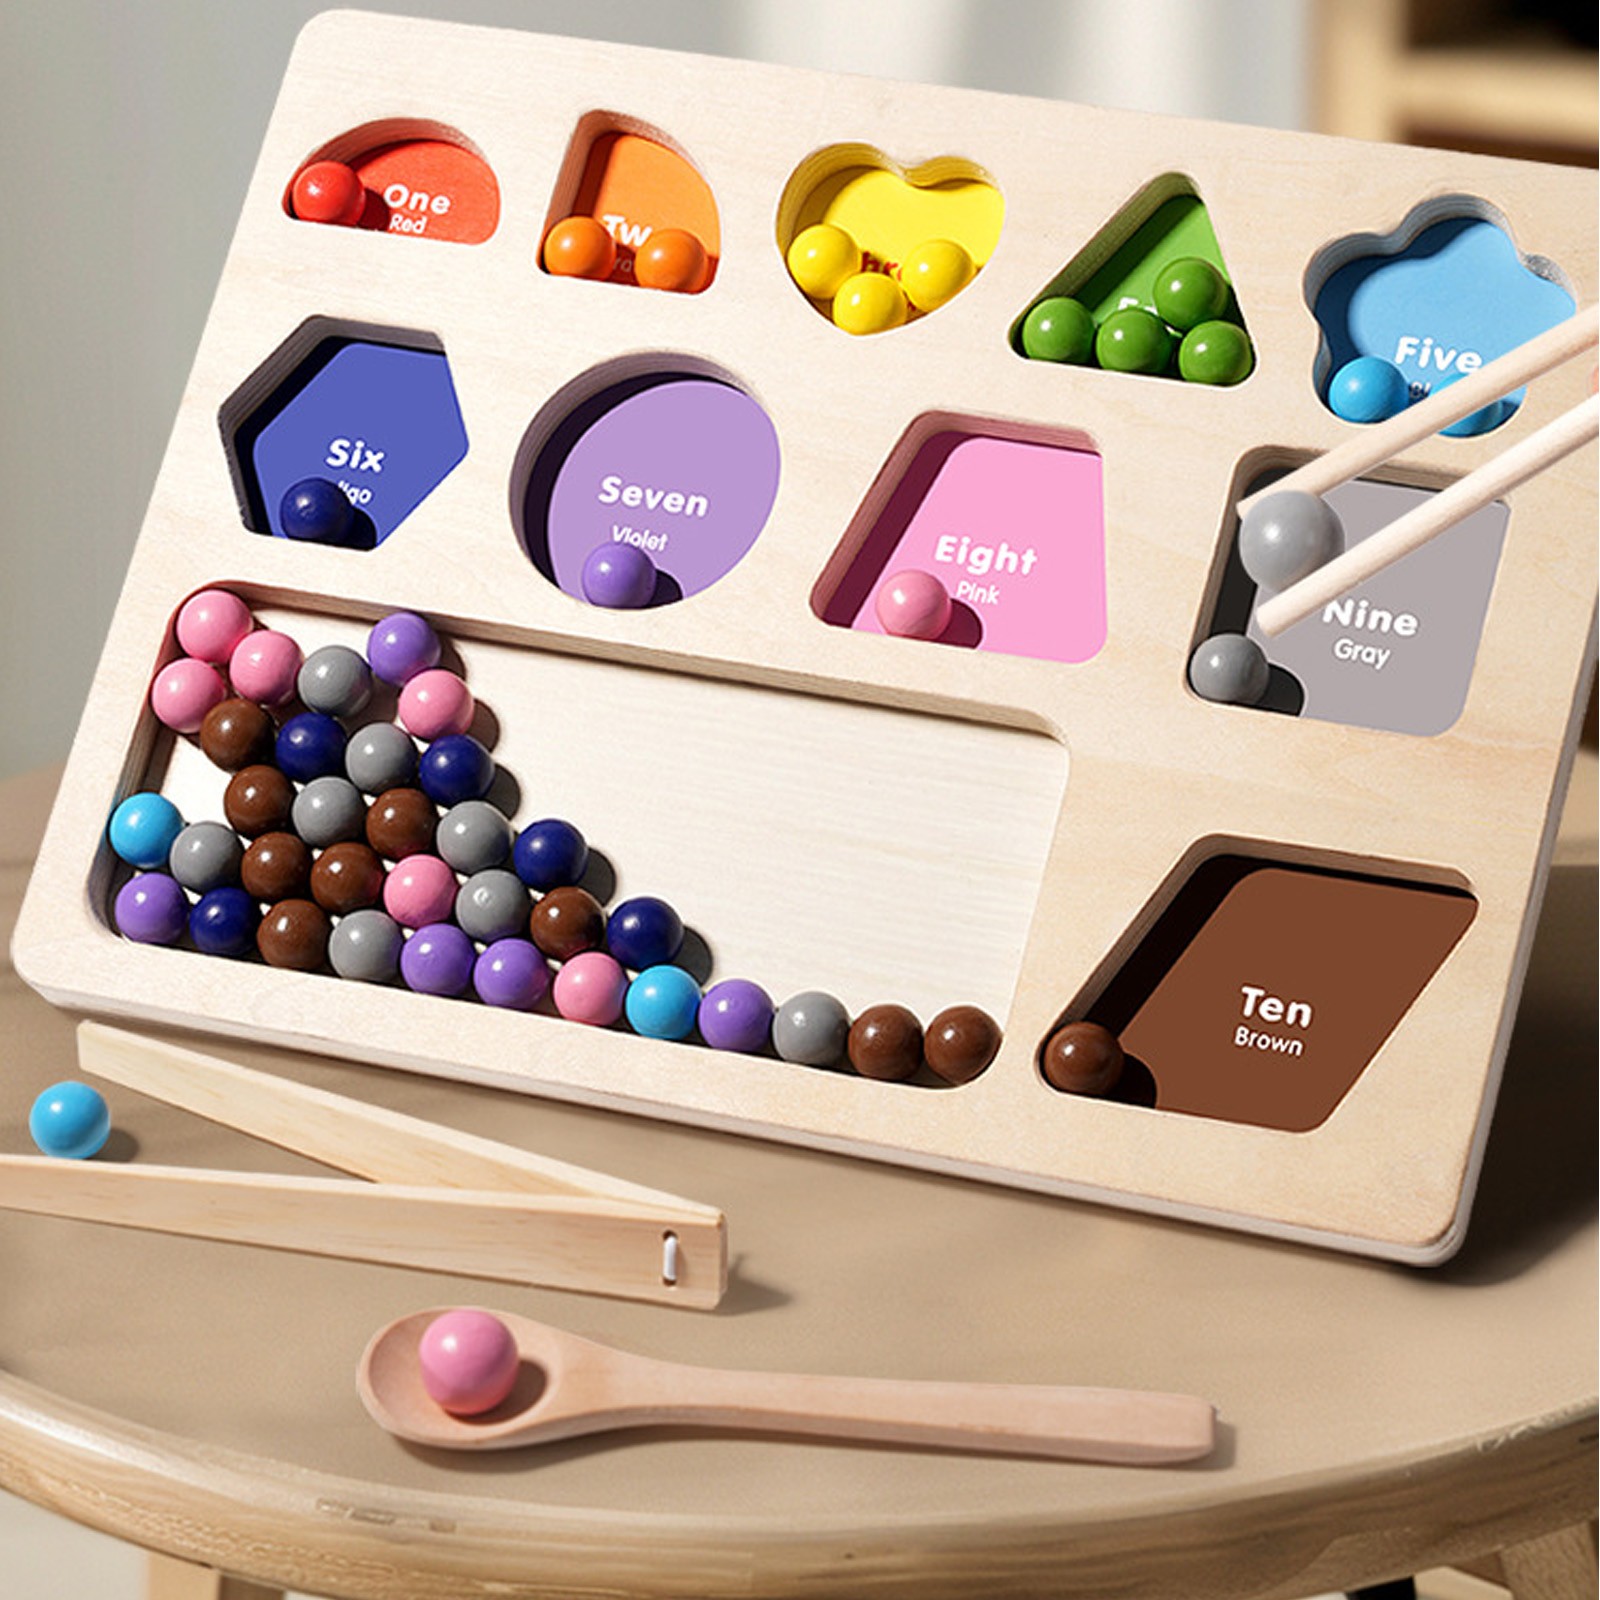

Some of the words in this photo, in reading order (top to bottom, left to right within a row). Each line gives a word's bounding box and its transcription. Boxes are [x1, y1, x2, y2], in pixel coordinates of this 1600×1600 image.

[383, 183, 451, 215] One
[389, 213, 428, 234] Red
[602, 214, 652, 247] Tw
[1394, 336, 1483, 374] Five
[325, 438, 385, 473] Six
[597, 475, 709, 517] Seven
[612, 524, 668, 551] Violet
[935, 534, 1038, 575] Eight
[956, 580, 1000, 605] Pink
[1322, 598, 1419, 636] Nine
[1333, 638, 1391, 670] Gray
[1241, 985, 1312, 1028] Ten
[1234, 1025, 1303, 1056] Brown
